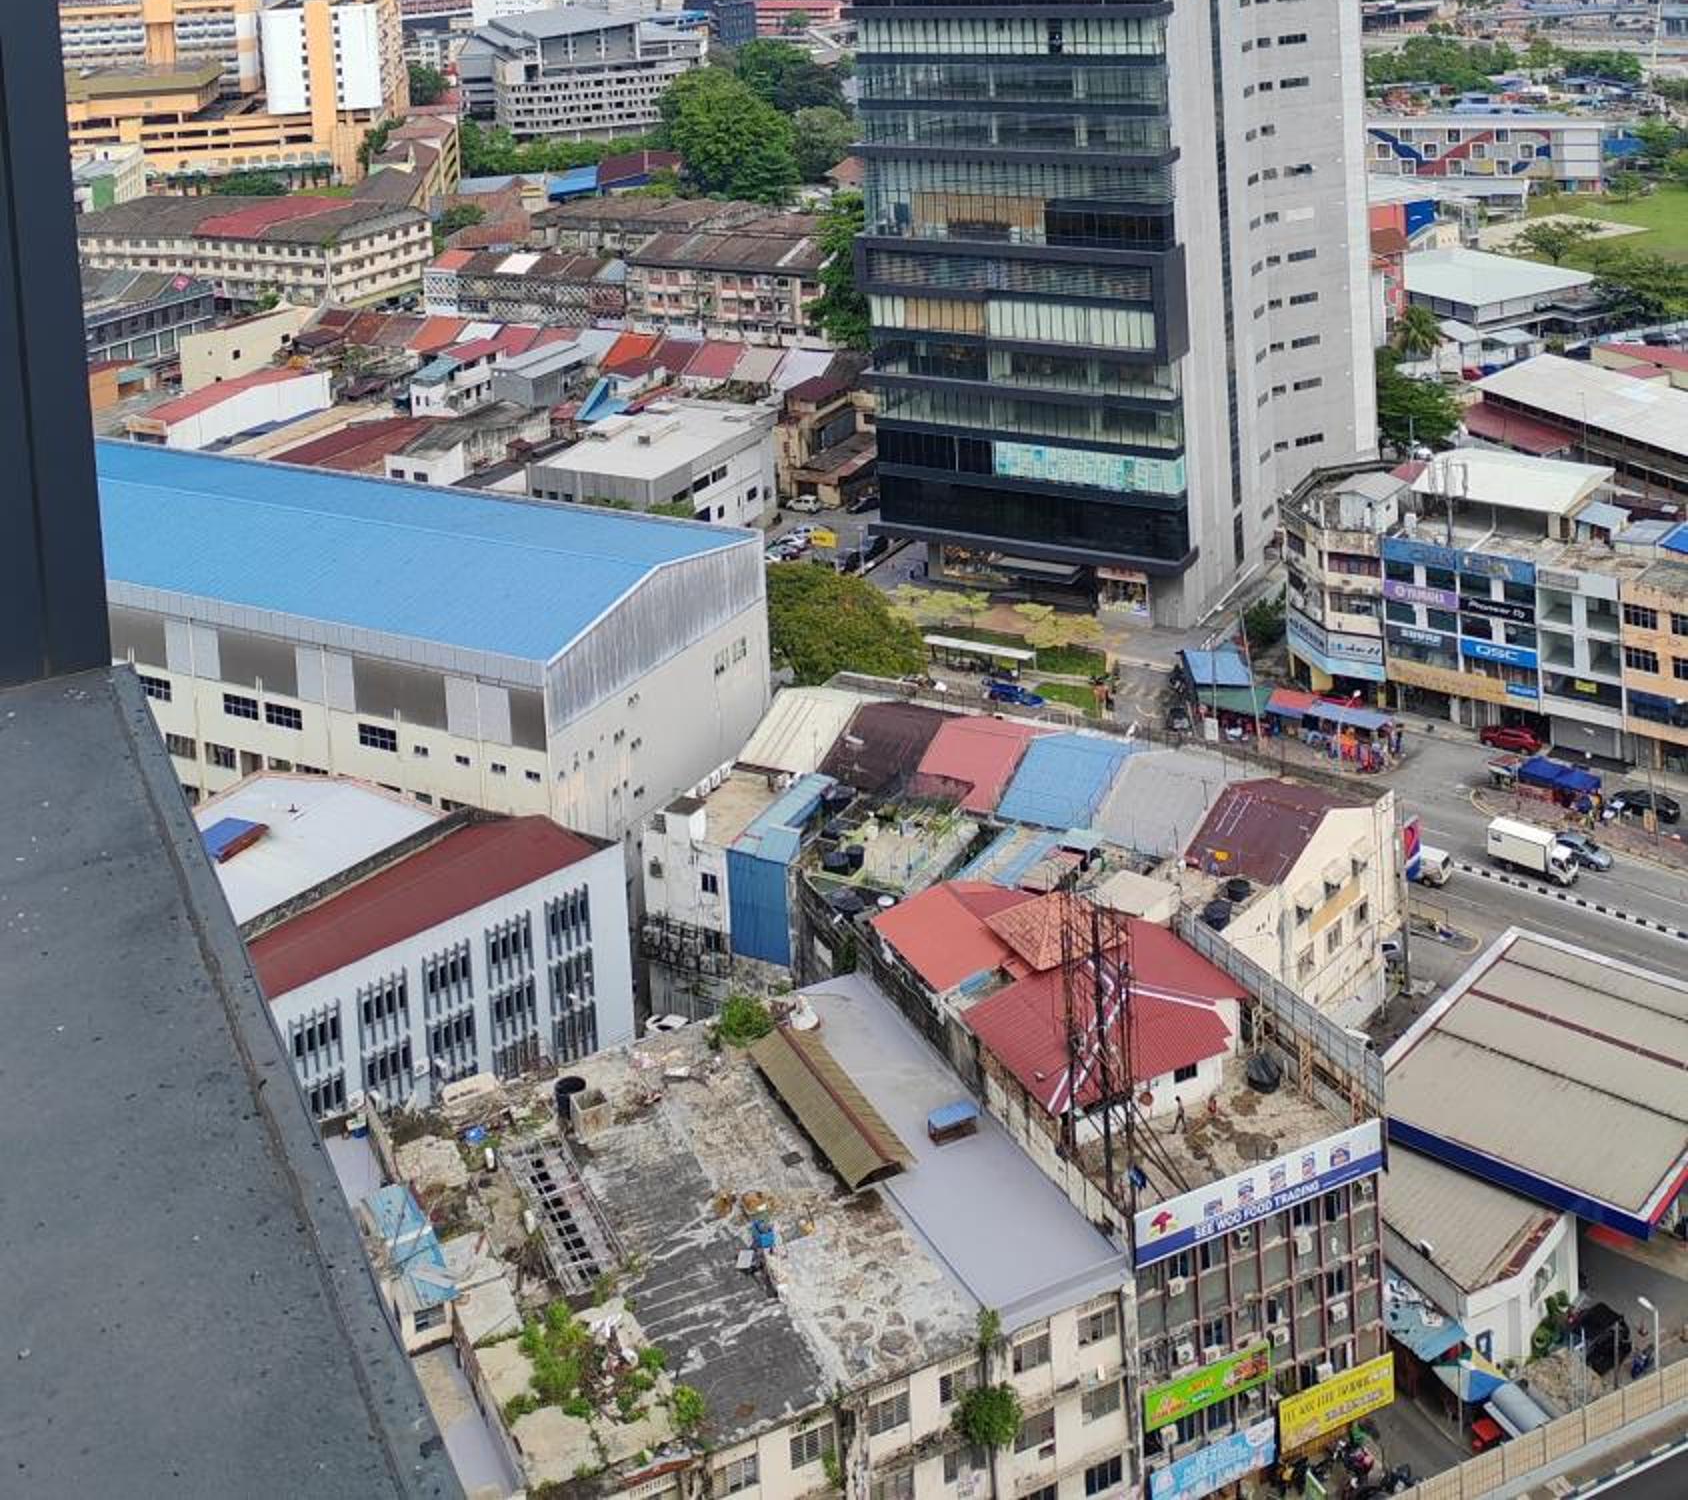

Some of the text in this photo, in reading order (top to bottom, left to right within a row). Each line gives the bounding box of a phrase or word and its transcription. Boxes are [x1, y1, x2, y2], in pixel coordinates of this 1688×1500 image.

[1468, 599, 1511, 614] Pioneer
[1475, 645, 1520, 660] QSC
[1195, 1182, 1320, 1239] SEE WOO FOOD TRADING
